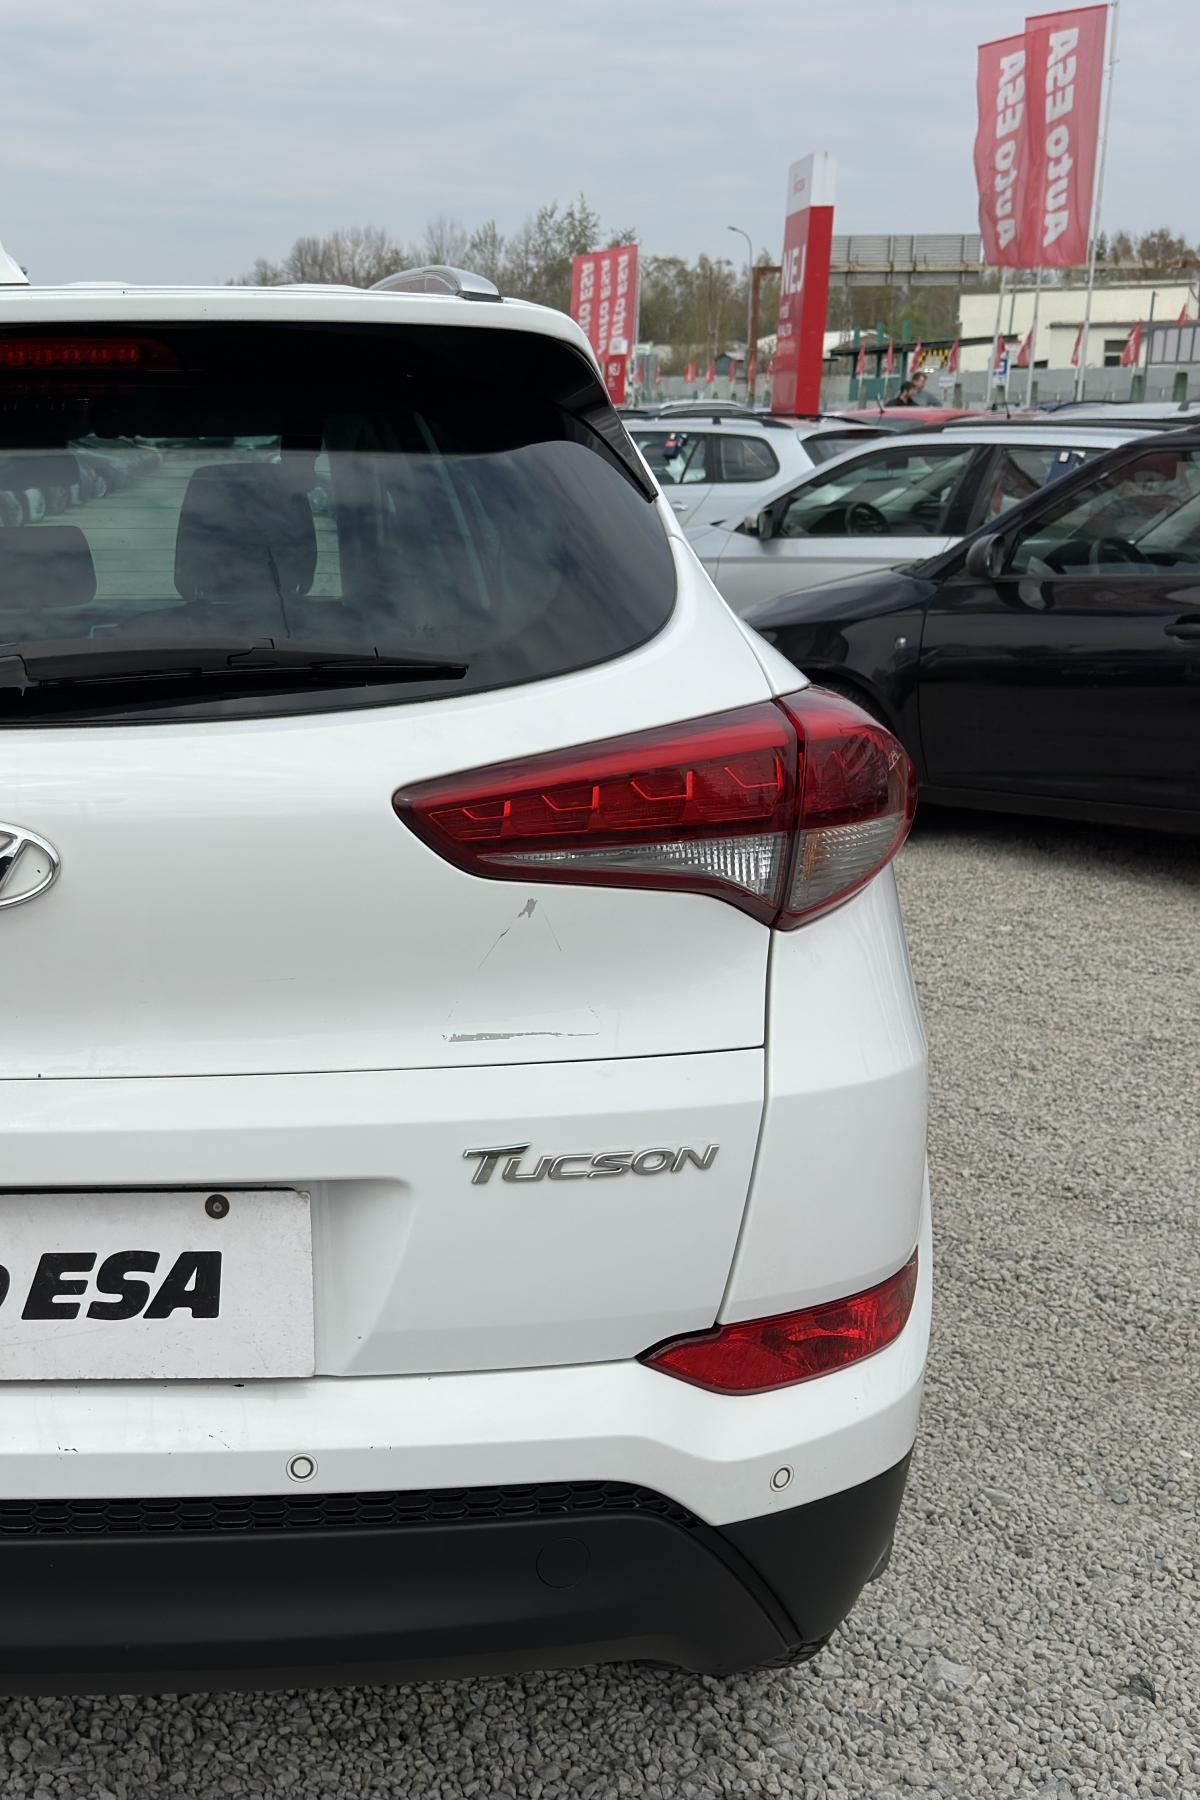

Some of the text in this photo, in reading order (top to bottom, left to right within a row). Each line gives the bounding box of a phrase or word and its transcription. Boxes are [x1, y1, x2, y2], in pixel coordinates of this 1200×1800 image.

[780, 244, 807, 296] NEJ
[462, 1142, 720, 1185] TUCSON
[20, 1250, 223, 1322] ESA
